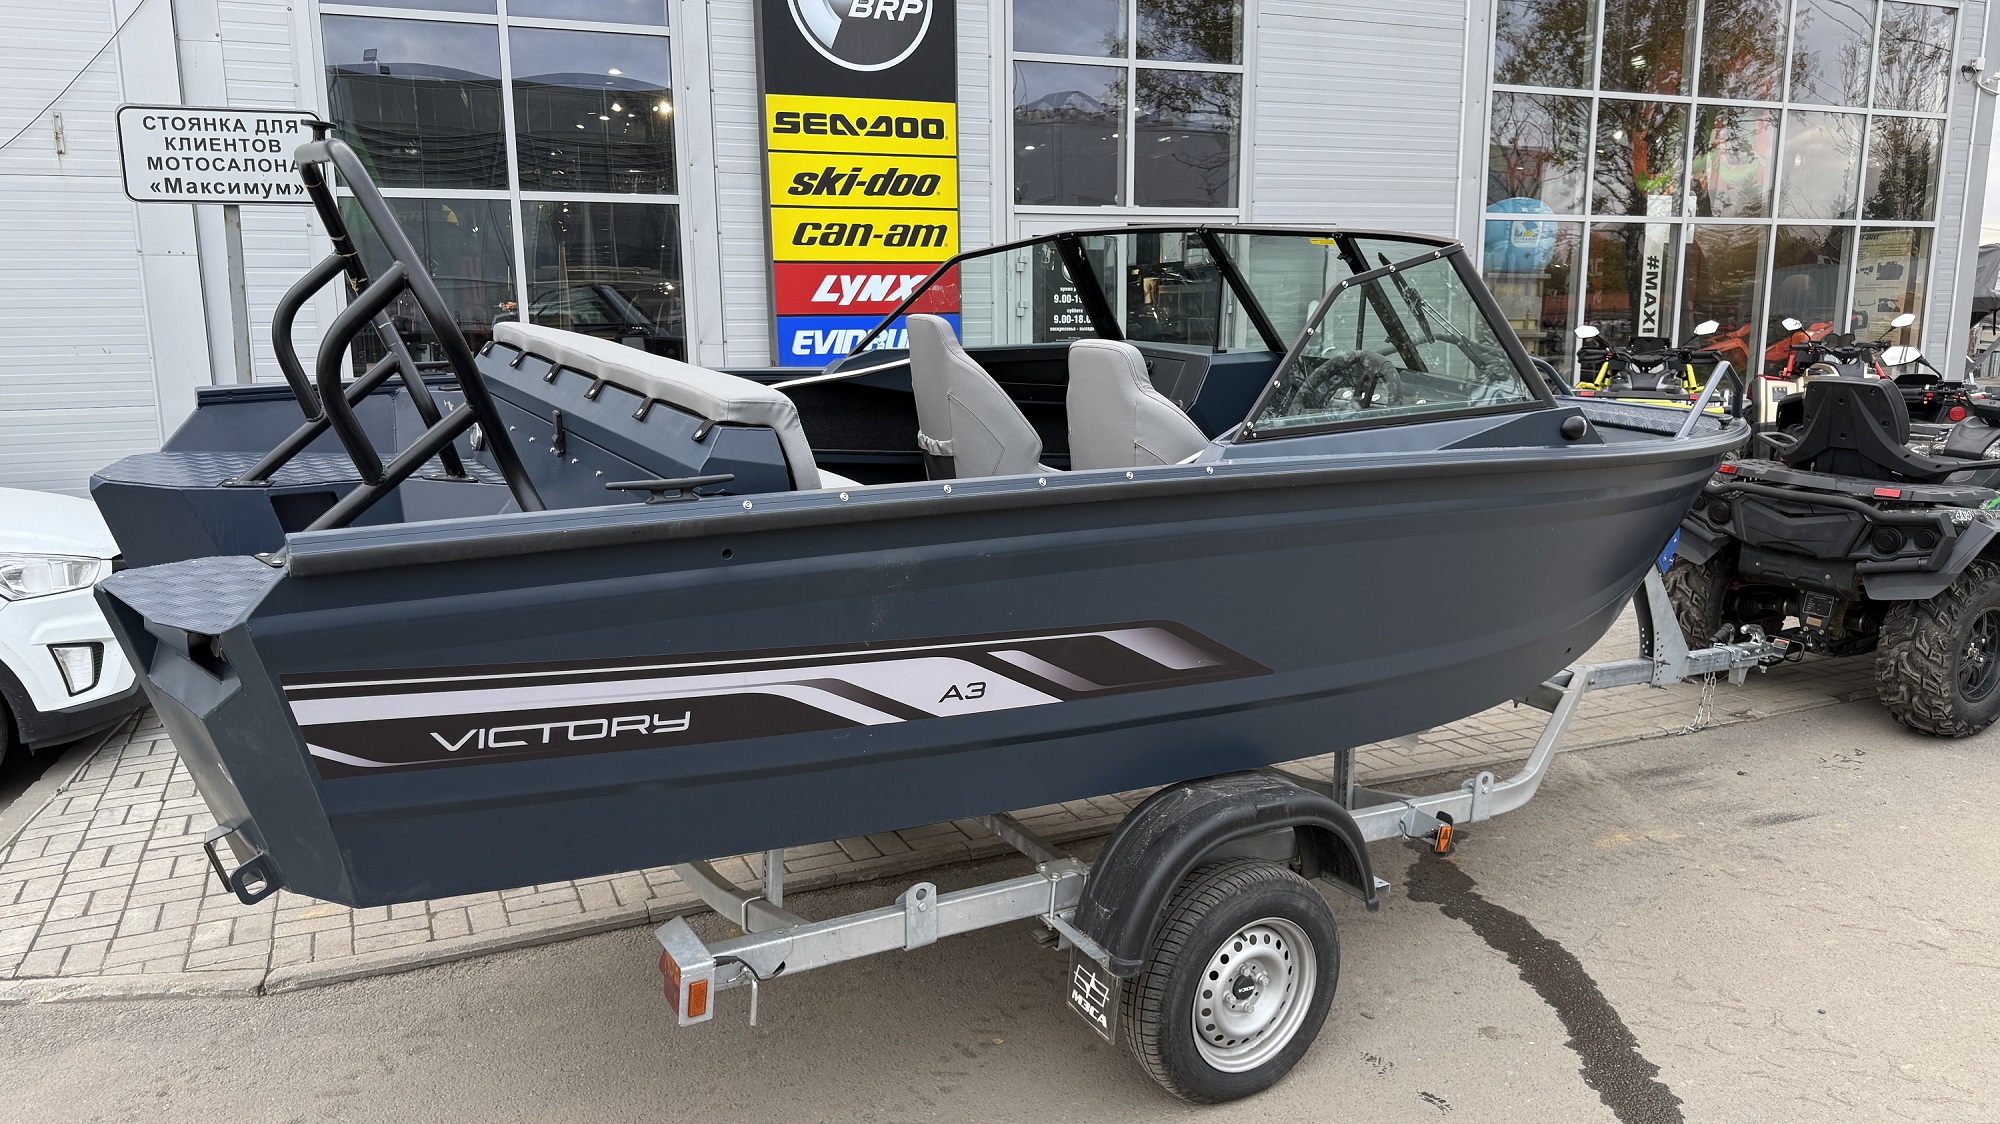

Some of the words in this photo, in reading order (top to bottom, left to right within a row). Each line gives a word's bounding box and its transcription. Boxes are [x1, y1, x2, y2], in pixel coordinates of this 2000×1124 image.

[848, 0, 924, 22] BRP
[142, 116, 247, 133] СТОЯНКА
[254, 119, 299, 136] ДЛЯ
[164, 137, 282, 153] КЛИЕНТОВ
[147, 156, 299, 173] МОТОСАЛОНА
[150, 178, 304, 199] «Максимум»
[788, 166, 941, 197] ski-doo
[792, 222, 948, 248] can-am
[811, 274, 929, 306] LYNX
[1642, 255, 1660, 334] #MAXI
[791, 328, 910, 356] EVINRU
[938, 681, 987, 704] A3
[429, 710, 691, 752] VICTORY
[1071, 989, 1108, 1029] МЗСА
